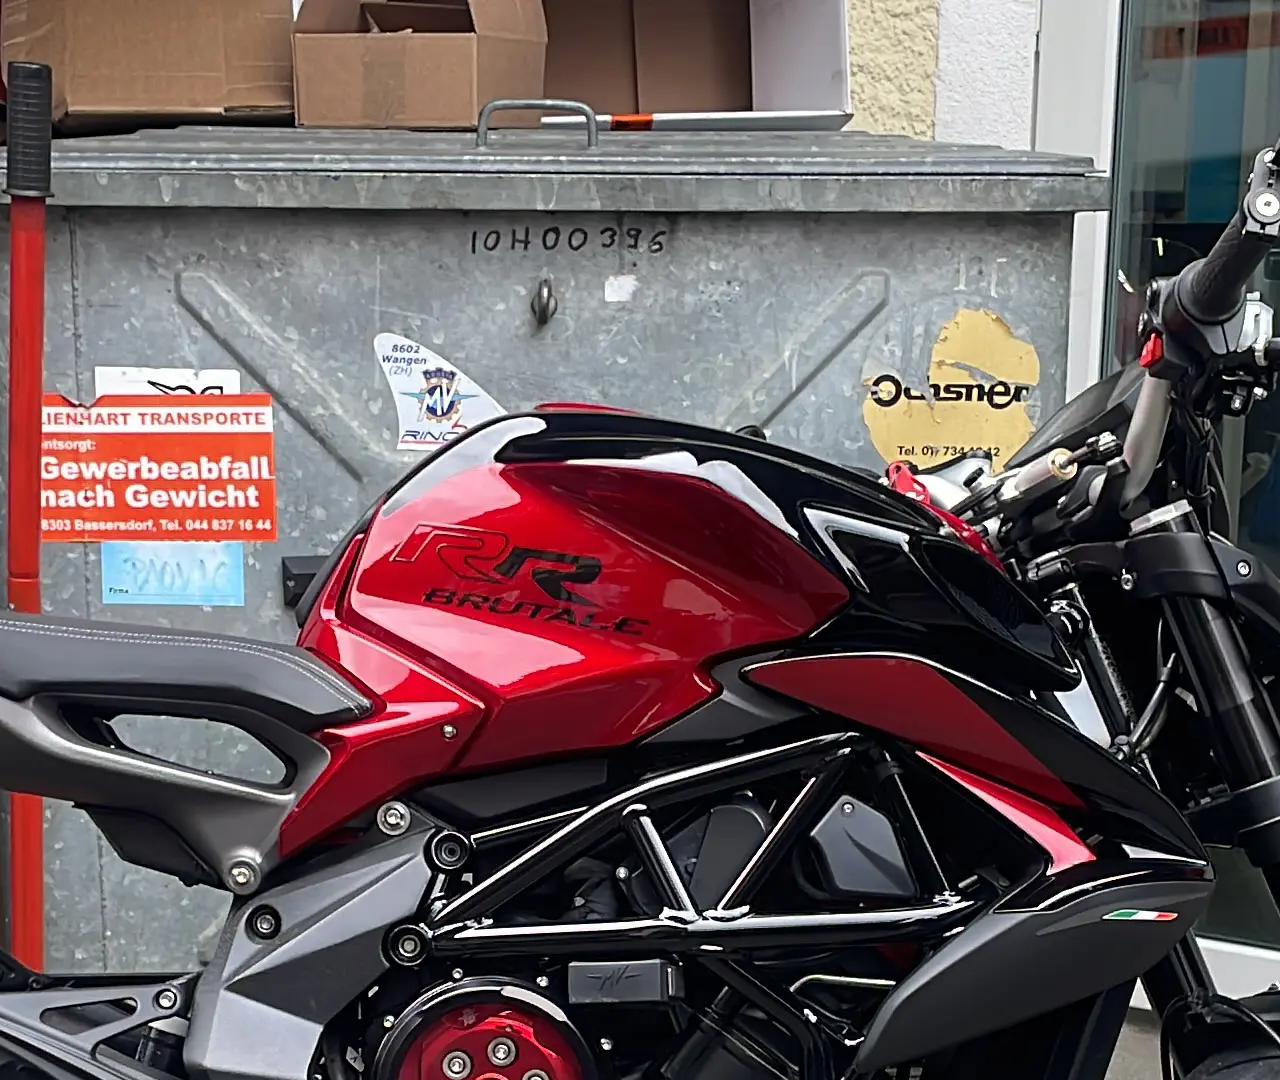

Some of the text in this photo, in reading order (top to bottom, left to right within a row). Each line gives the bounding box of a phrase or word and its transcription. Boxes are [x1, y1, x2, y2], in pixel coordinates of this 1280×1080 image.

[391, 344, 421, 354] 8602
[382, 355, 427, 366] Wangen
[389, 366, 413, 377] (ZH)
[138, 412, 266, 426] TRANSPORTE
[897, 445, 918, 457] Tel.
[41, 455, 276, 480] Gewerbeabfall
[41, 484, 260, 508] nach Gewicht
[41, 519, 272, 532] 8303 Bassersdorf, Tel. 044 837 16 44
[421, 588, 650, 636] BRUTALE
